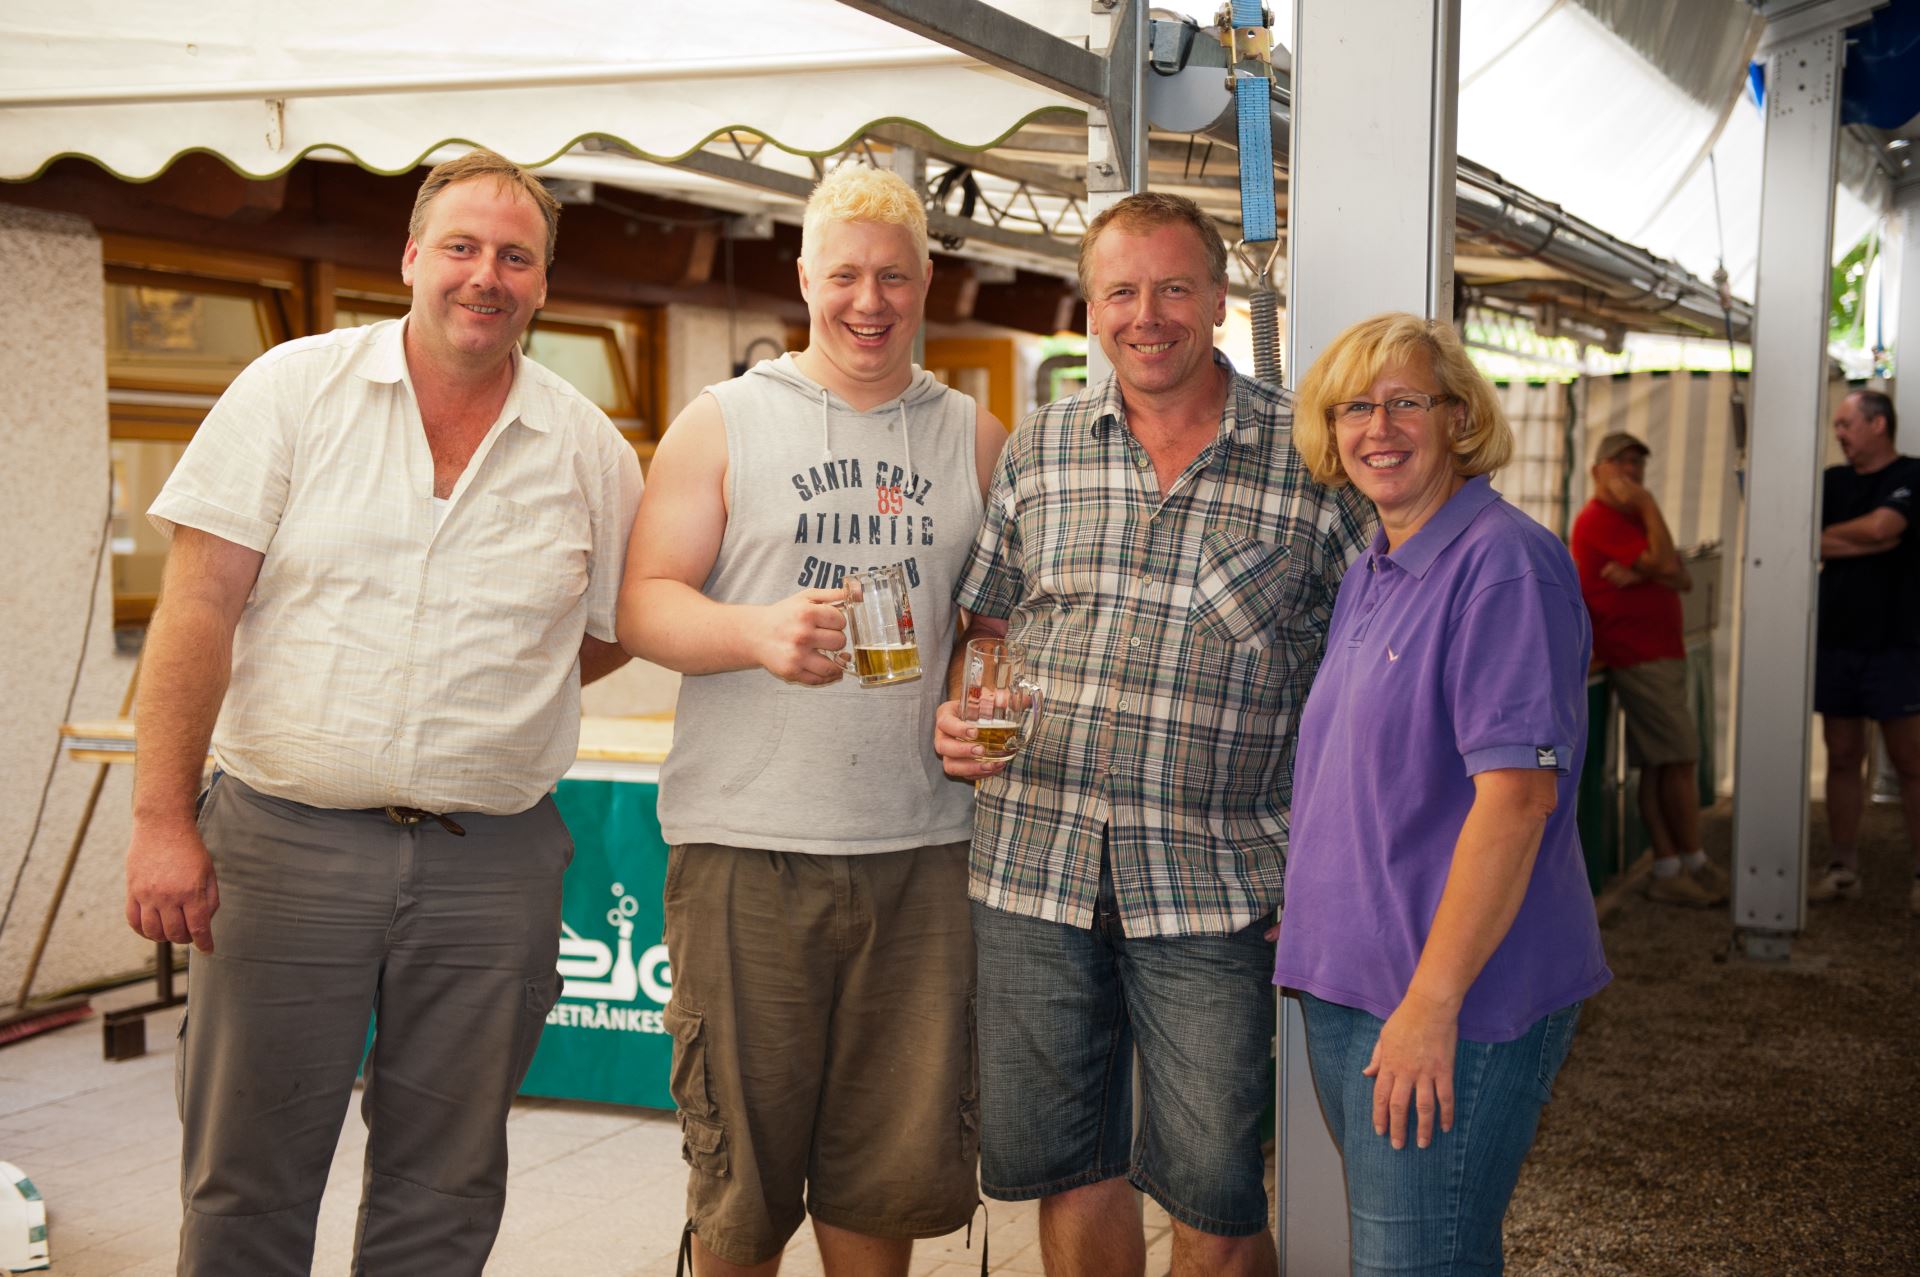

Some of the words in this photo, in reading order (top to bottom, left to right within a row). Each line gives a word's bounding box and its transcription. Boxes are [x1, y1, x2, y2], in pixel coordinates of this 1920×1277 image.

[791, 458, 863, 502] SANTA
[875, 460, 933, 506] CRUZ
[877, 485, 904, 515] 89
[794, 512, 934, 546] ATLANTIC
